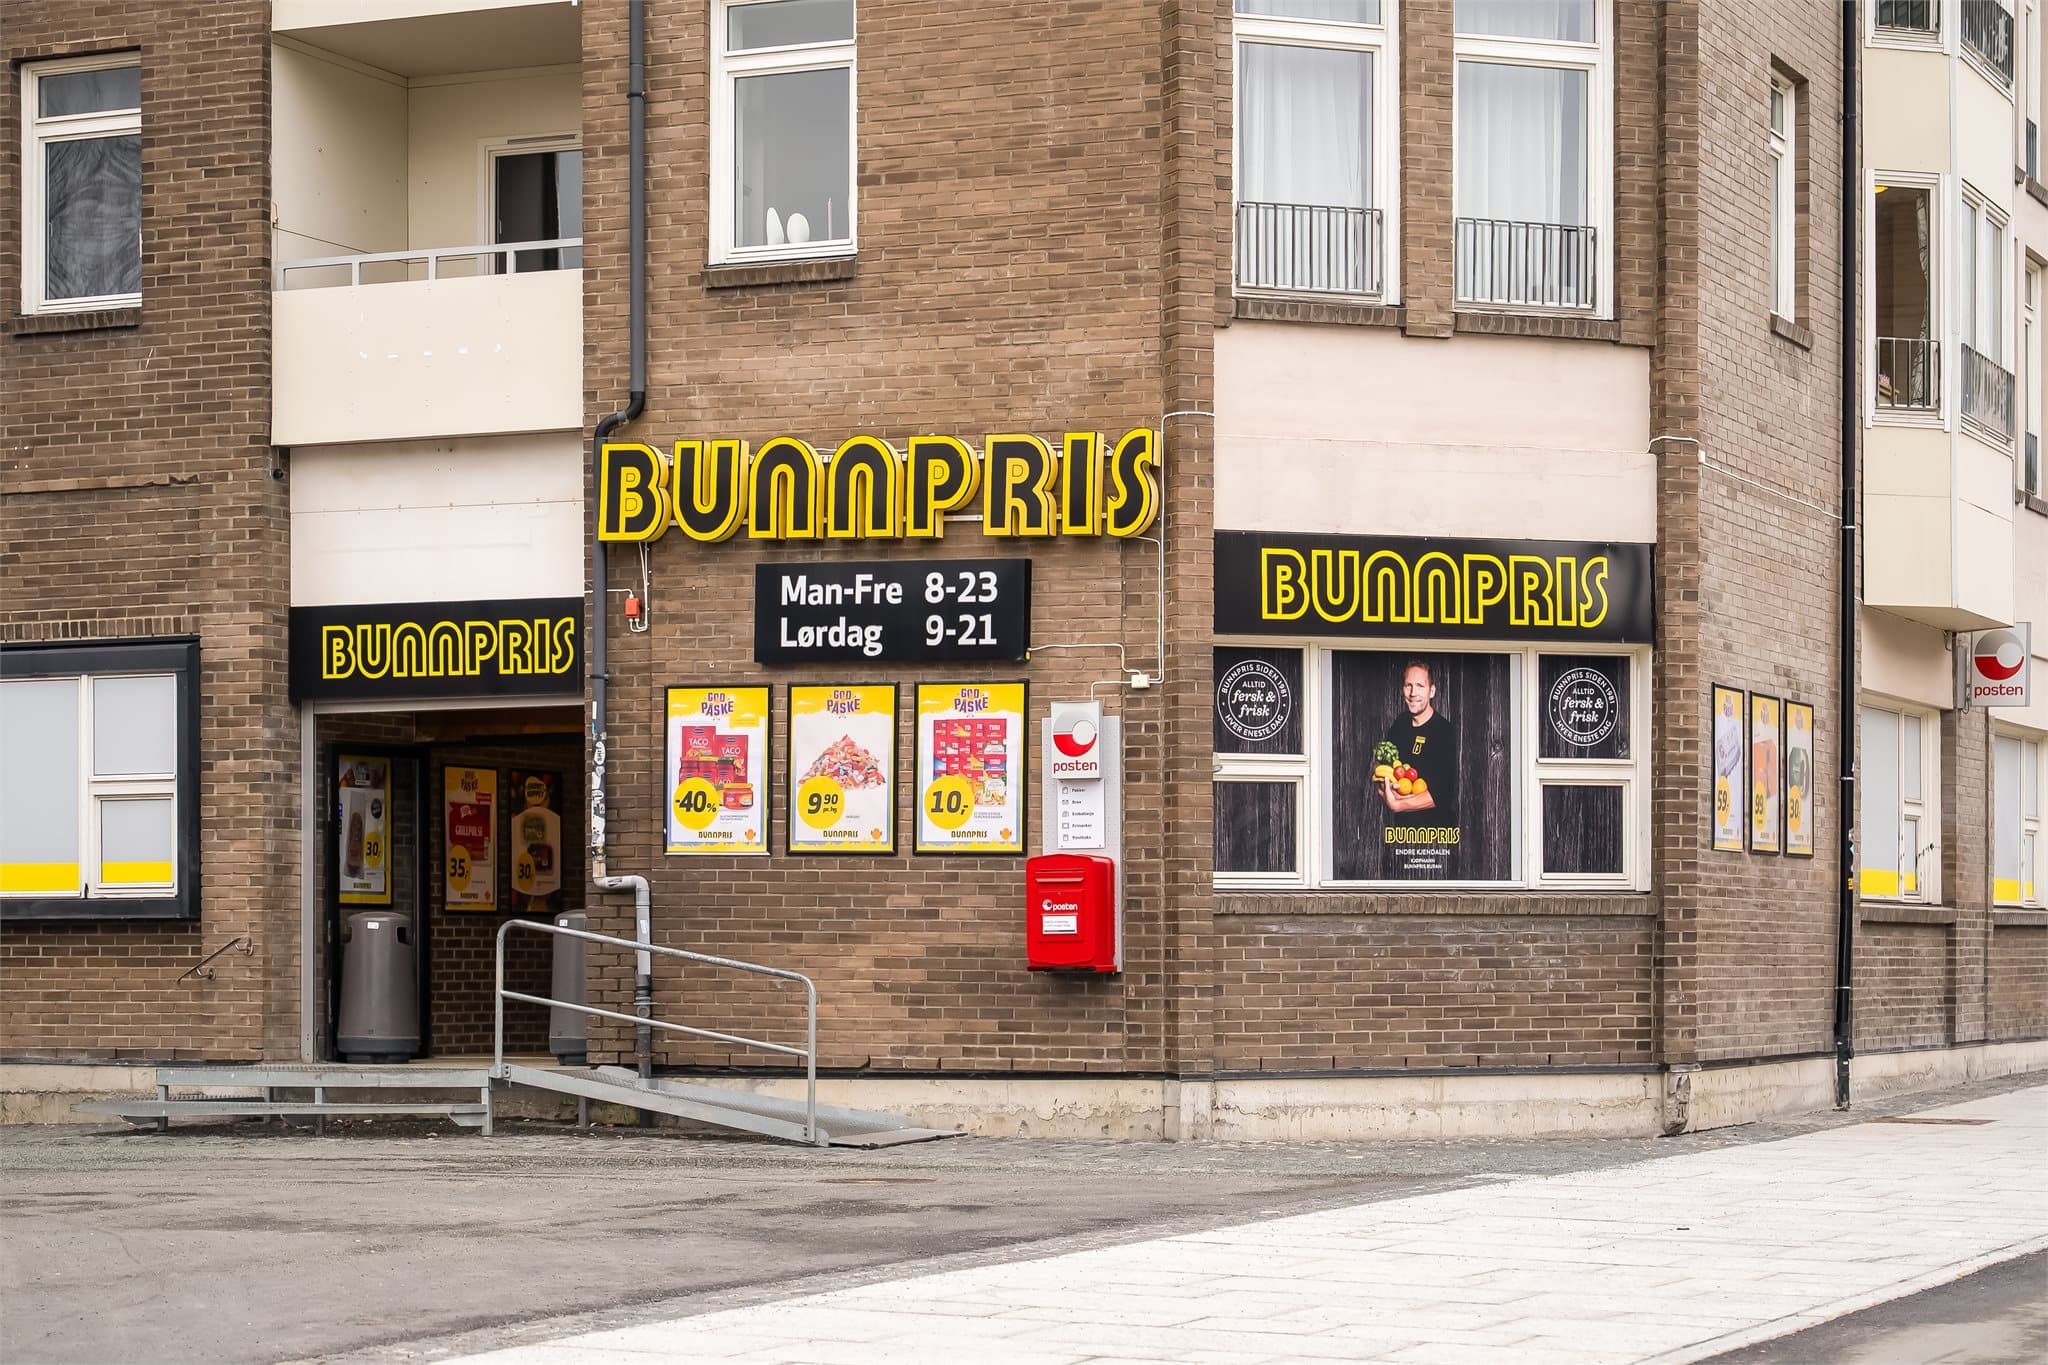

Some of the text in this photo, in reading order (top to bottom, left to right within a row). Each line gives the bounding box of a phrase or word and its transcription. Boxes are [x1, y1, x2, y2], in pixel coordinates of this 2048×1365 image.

[598, 428, 1161, 543] BUNNPRIS
[781, 571, 998, 606] Man-Fre 8-23
[1261, 548, 1609, 628] BUNNPRIS
[780, 613, 998, 656] Lørdag 9-21
[322, 617, 574, 679] BUNNPRIS
[1222, 664, 1254, 694] BUNNPRIS
[1256, 664, 1279, 681] SIDEN
[1242, 680, 1266, 688] ALLTID
[1552, 672, 1584, 700] BUNNPRIS
[1585, 672, 1607, 688] SIDEN
[708, 692, 726, 702] GOD
[833, 690, 852, 700] GOD
[961, 688, 980, 698] GOD
[1231, 689, 1276, 704] fersk &
[1974, 684, 2024, 698] posten
[1562, 696, 1604, 710] fersk &
[1238, 704, 1270, 718] frisk
[1568, 710, 1599, 724] frisk
[1224, 714, 1284, 737] HVER ENESTE DAG
[1556, 720, 1612, 742] HVER ENESTE DAG
[688, 738, 708, 746] TACO
[1053, 760, 1098, 774] posten
[930, 790, 968, 816] 10,-
[823, 830, 858, 838] BUNNPRIS
[1385, 827, 1460, 844] BUNNPRIS
[1052, 903, 1078, 912] posten
